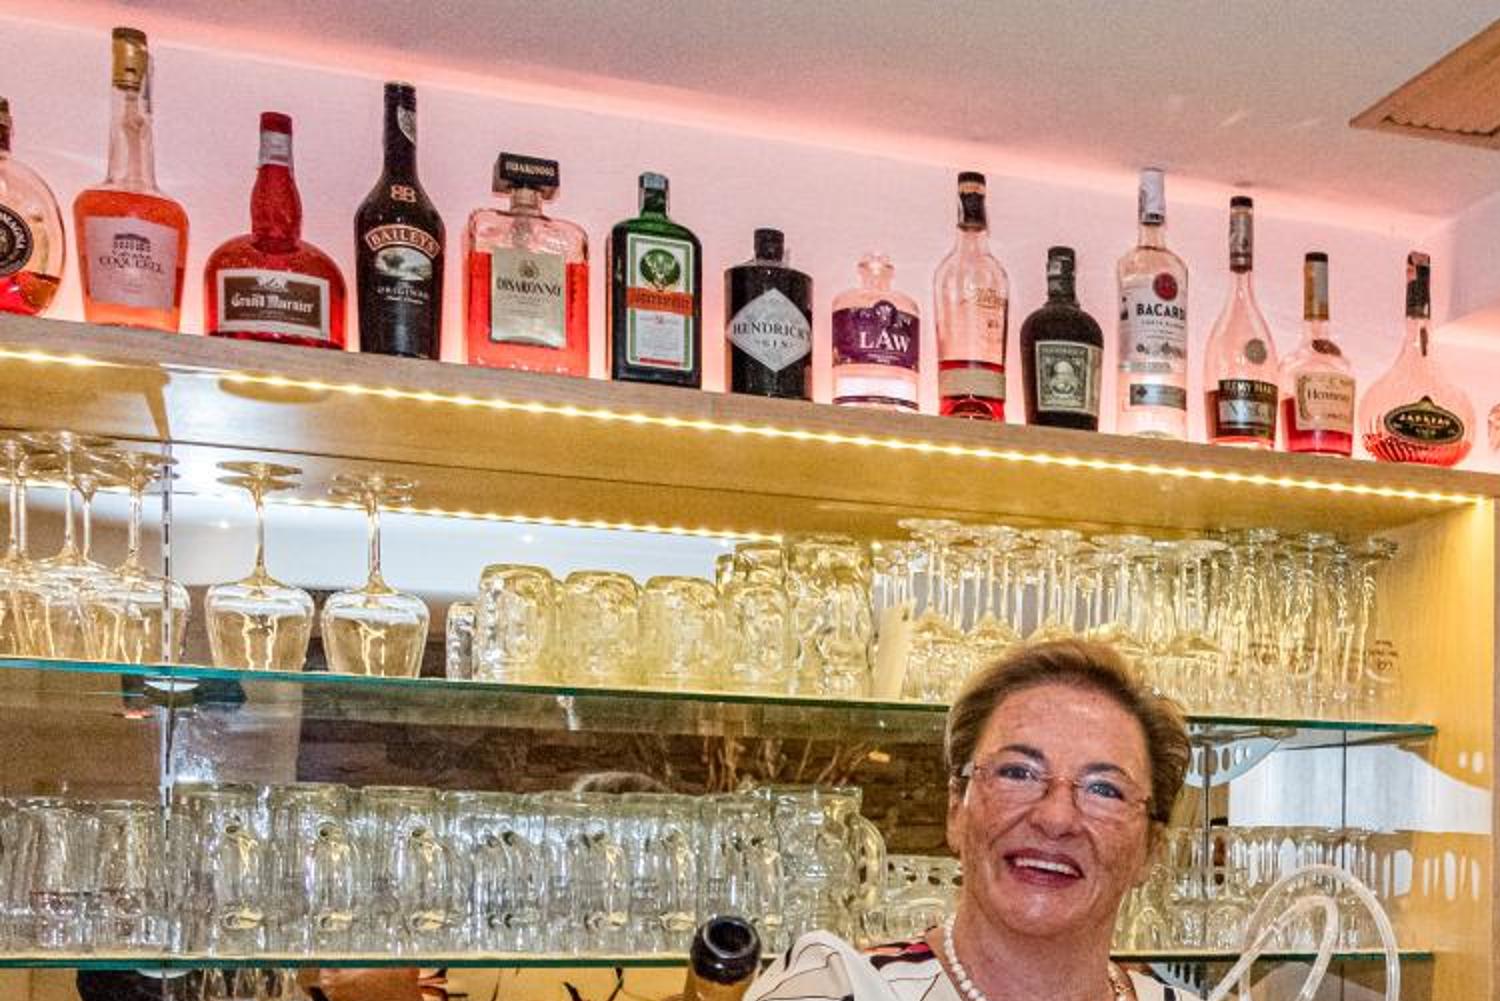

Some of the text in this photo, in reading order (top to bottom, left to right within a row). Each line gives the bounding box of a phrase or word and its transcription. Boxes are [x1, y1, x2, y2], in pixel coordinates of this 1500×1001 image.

[370, 229, 435, 254] BAILEYS
[1136, 304, 1186, 321] BACARD
[860, 328, 911, 353] LAW
